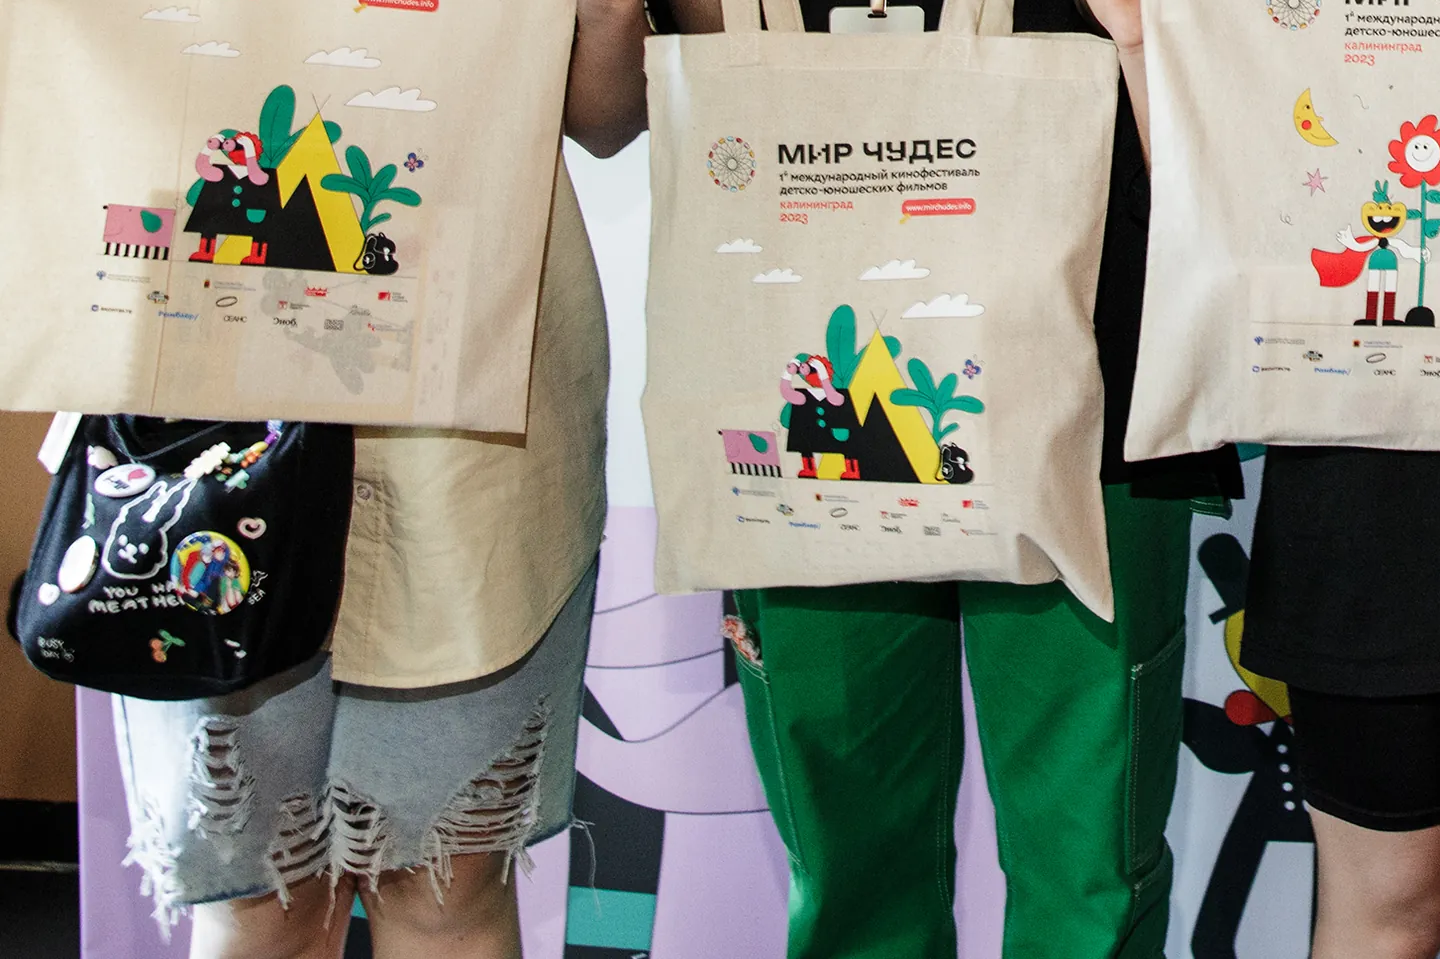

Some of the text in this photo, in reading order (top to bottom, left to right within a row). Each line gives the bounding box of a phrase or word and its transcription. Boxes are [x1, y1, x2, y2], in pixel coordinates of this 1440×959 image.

[1344, 41, 1423, 53] калининград
[1344, 53, 1375, 66] 2023
[778, 138, 977, 165] МИР ЧУДЕС
[790, 169, 889, 183] международный
[891, 167, 981, 182] кинофестиваль
[780, 181, 948, 196] детско-юношеских фильмов
[780, 200, 854, 211] калининград
[780, 212, 808, 224] 2023
[103, 585, 139, 599] YOU
